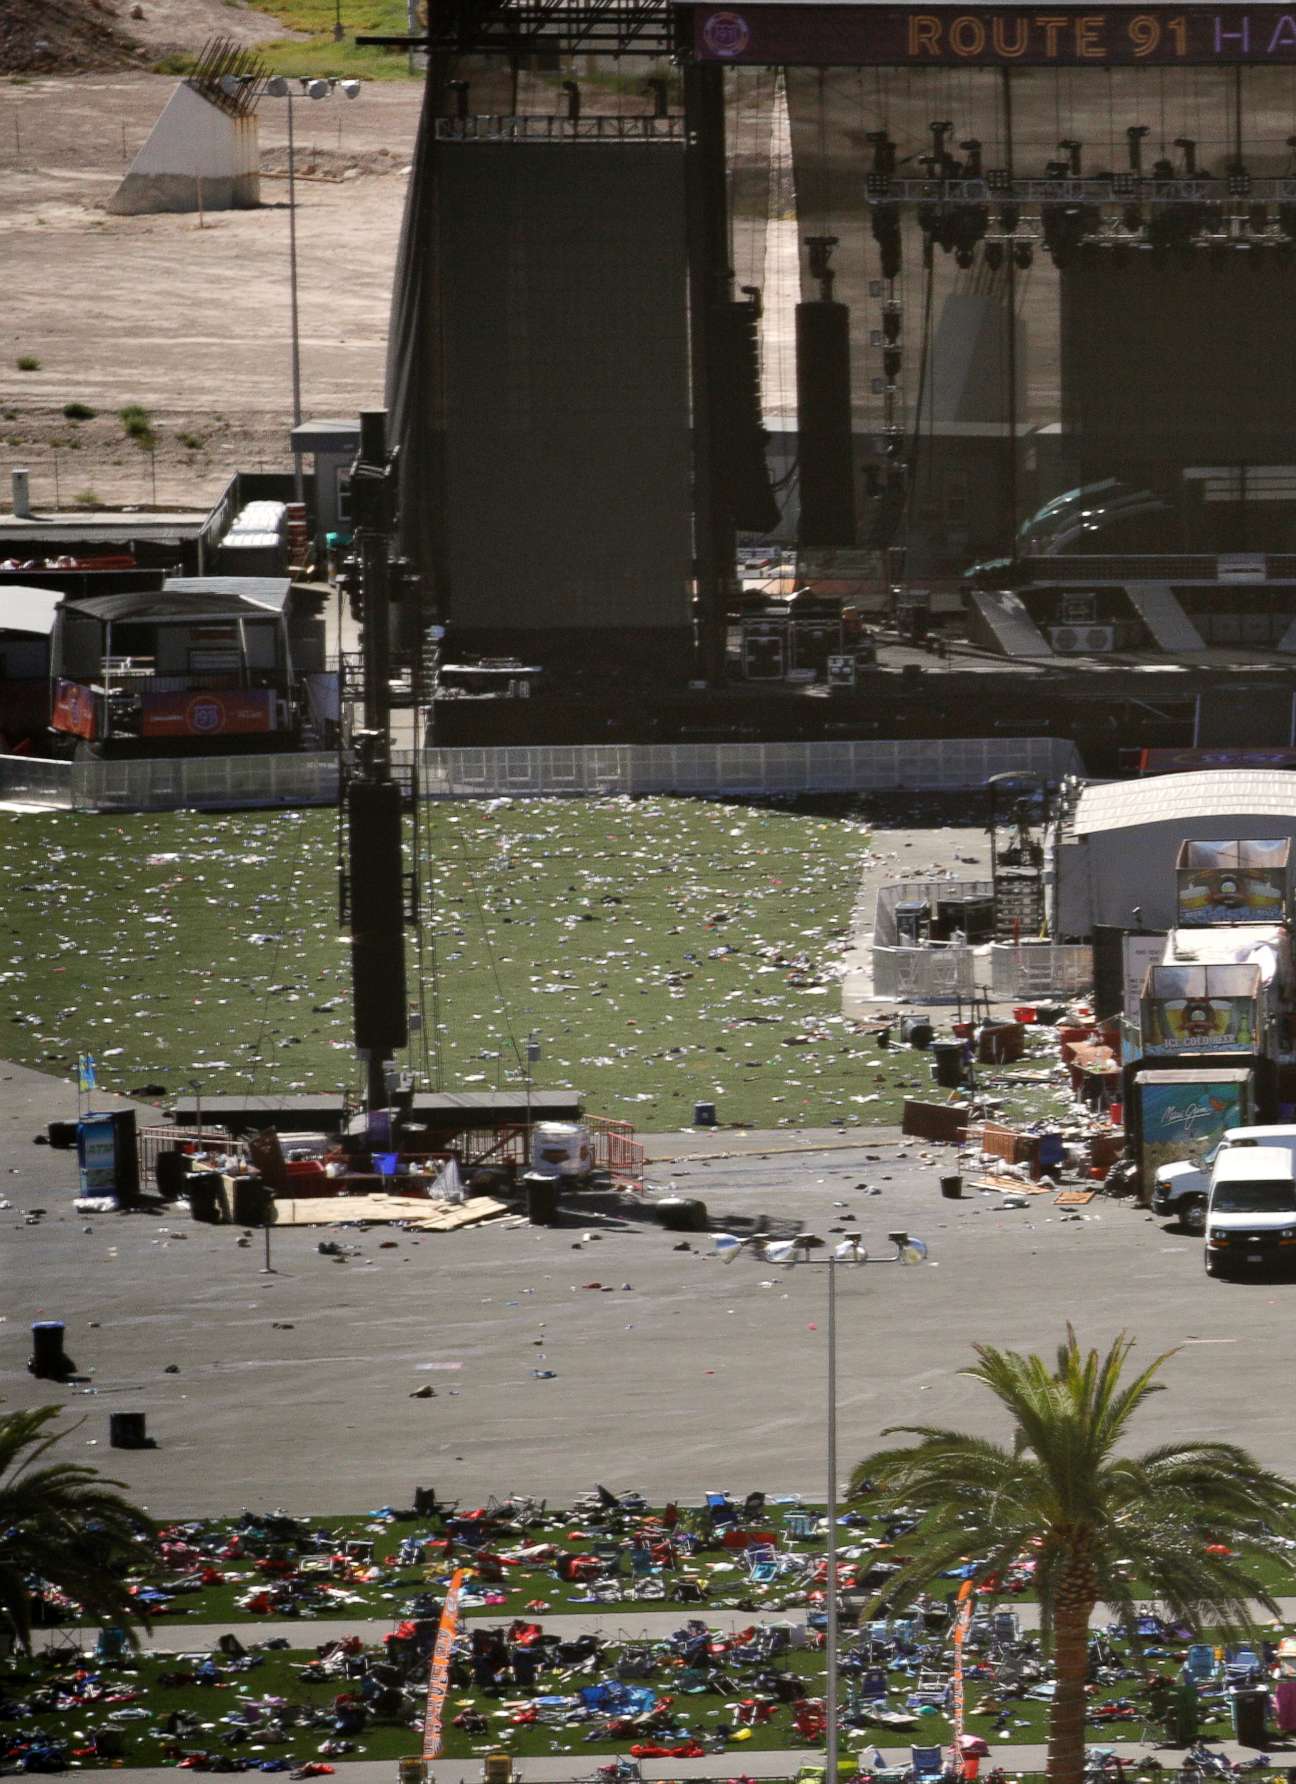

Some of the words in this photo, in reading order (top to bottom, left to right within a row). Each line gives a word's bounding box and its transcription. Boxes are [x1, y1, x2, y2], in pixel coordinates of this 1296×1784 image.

[908, 15, 1106, 58] ROUTE
[1128, 15, 1188, 57] 91
[1183, 1036, 1209, 1047] COLD
